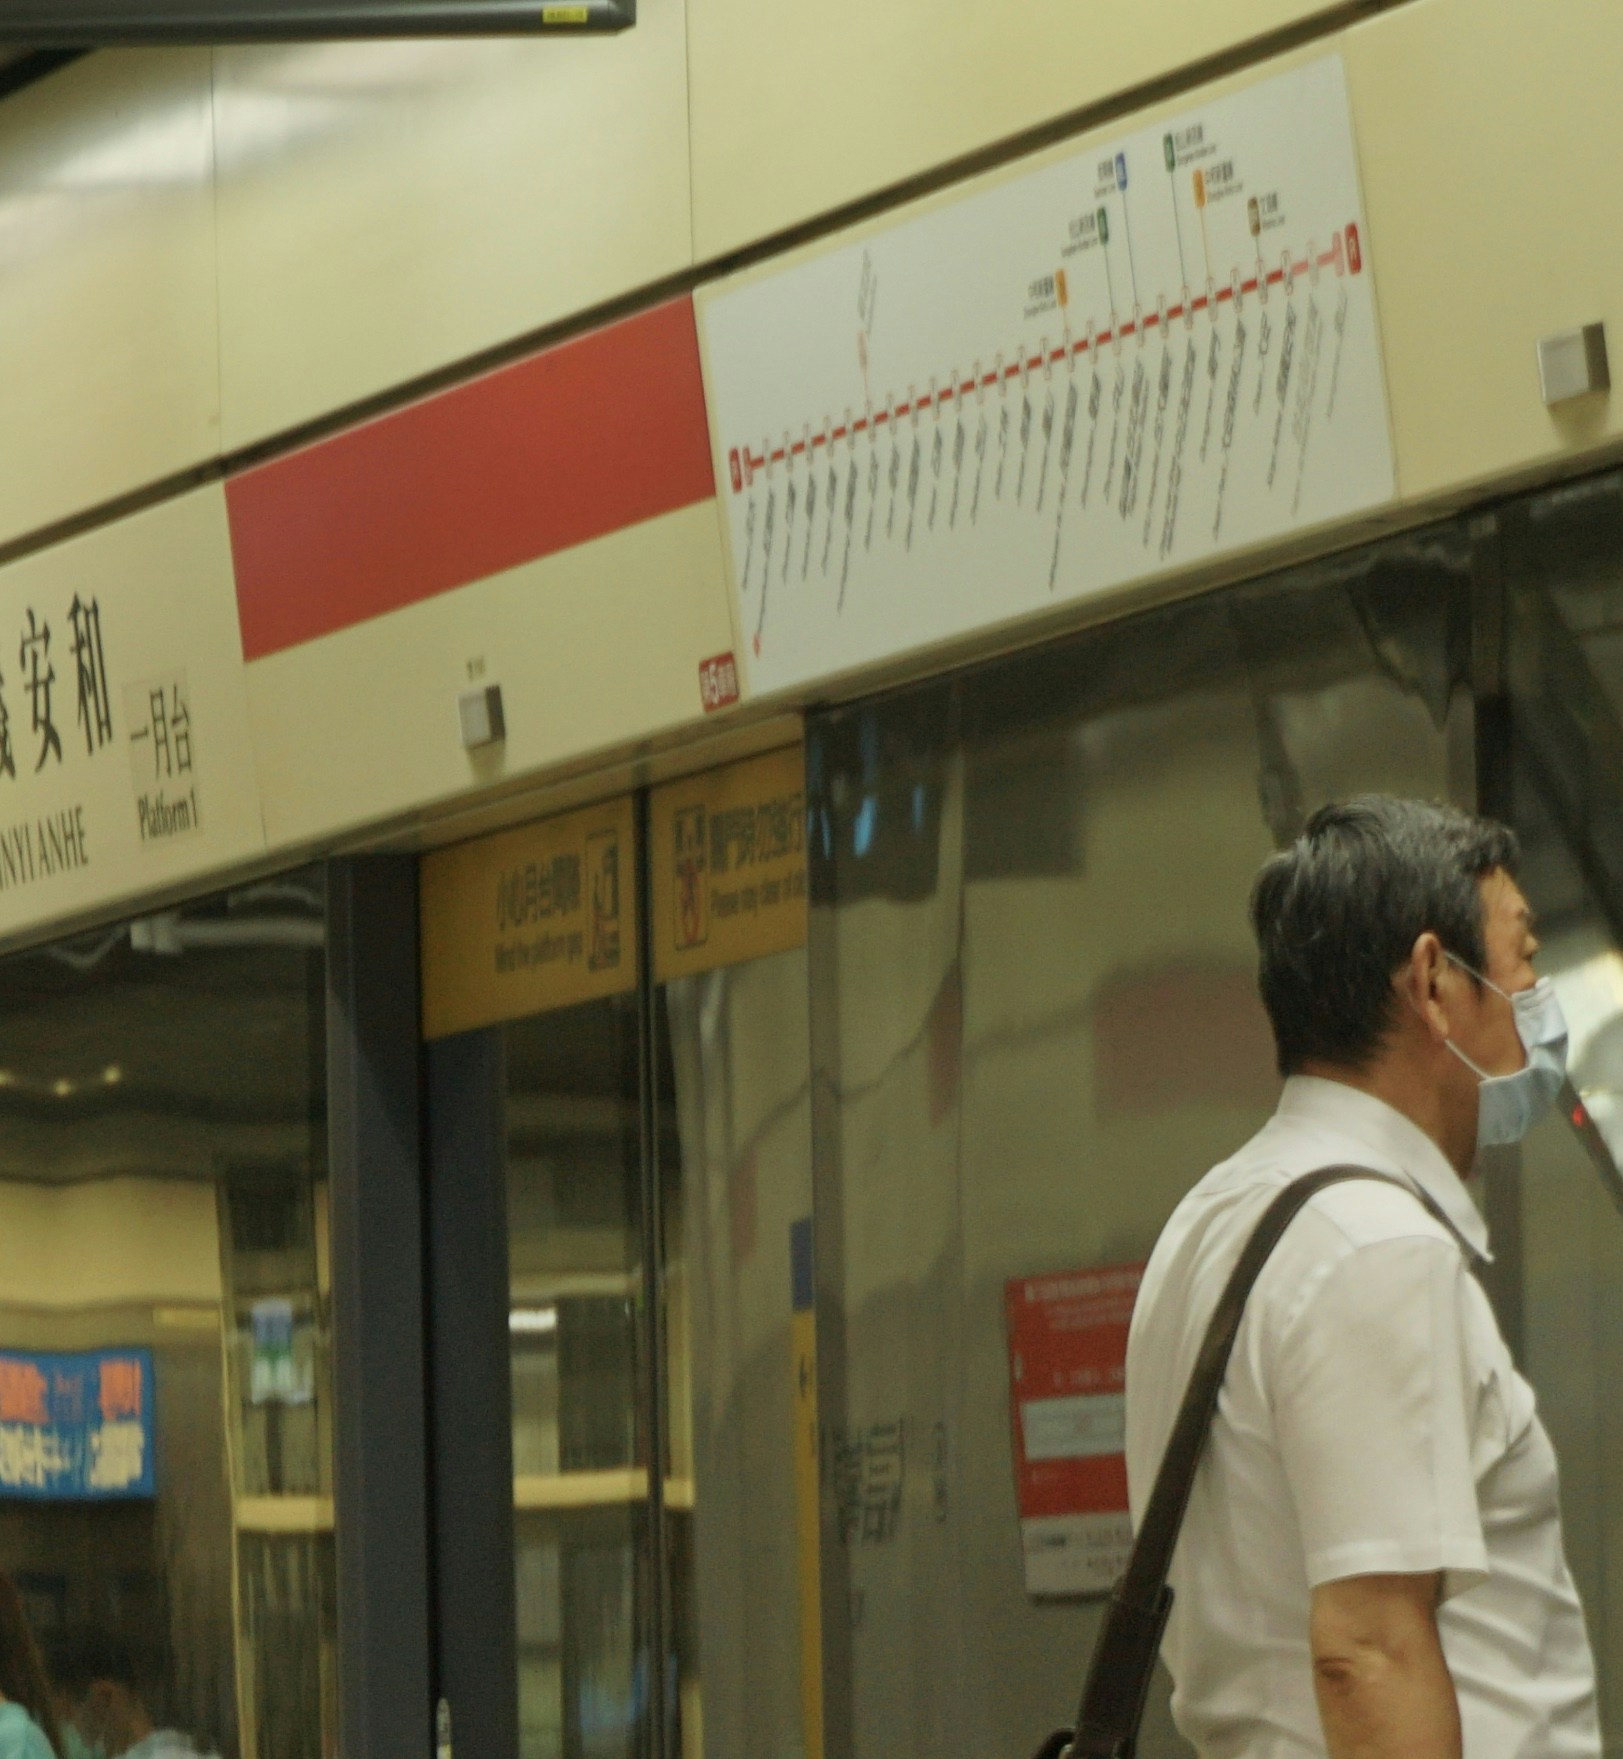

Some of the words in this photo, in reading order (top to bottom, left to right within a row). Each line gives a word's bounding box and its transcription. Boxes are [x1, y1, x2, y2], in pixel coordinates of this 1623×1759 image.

[131, 682, 192, 780] 一月台
[137, 788, 190, 842] Platform
